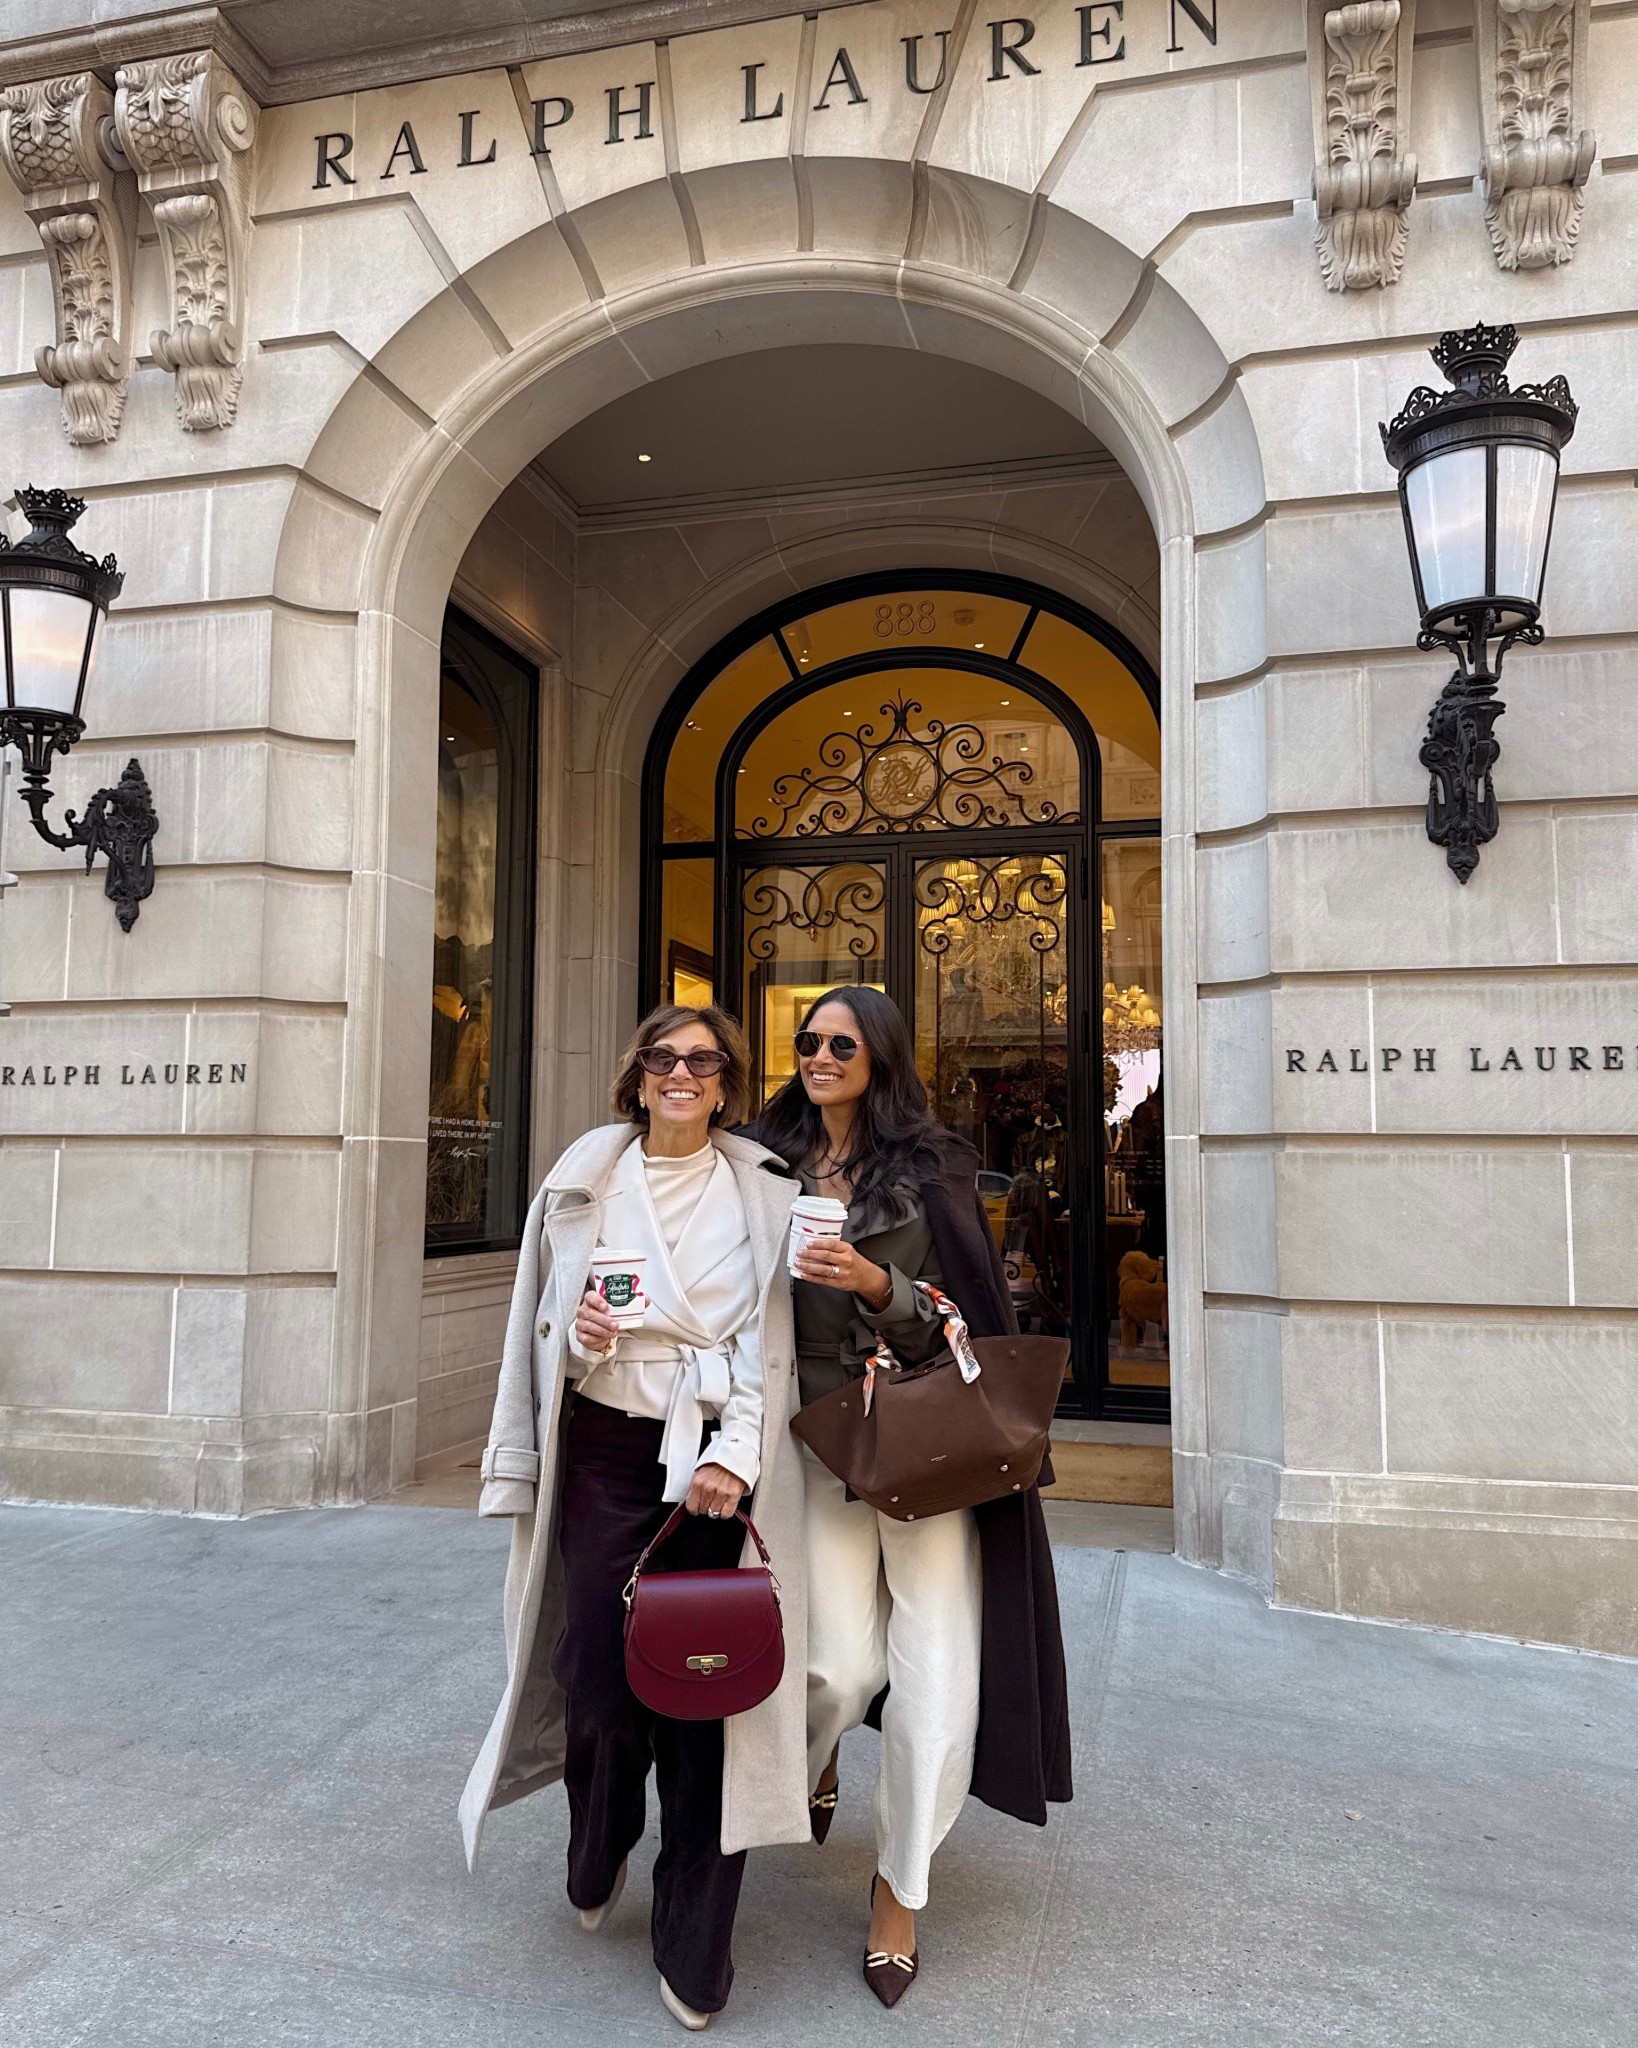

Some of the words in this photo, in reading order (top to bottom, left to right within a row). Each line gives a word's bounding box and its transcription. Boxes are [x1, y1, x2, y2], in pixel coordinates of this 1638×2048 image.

[311, 81, 656, 190] RALPH
[739, 0, 1218, 123] LAUREN
[873, 601, 936, 638] 888
[1, 1065, 100, 1086] RALPH
[121, 1063, 248, 1086] LAUREN
[1286, 1048, 1437, 1073] RALPH
[1470, 1046, 1638, 1072] LAURE
